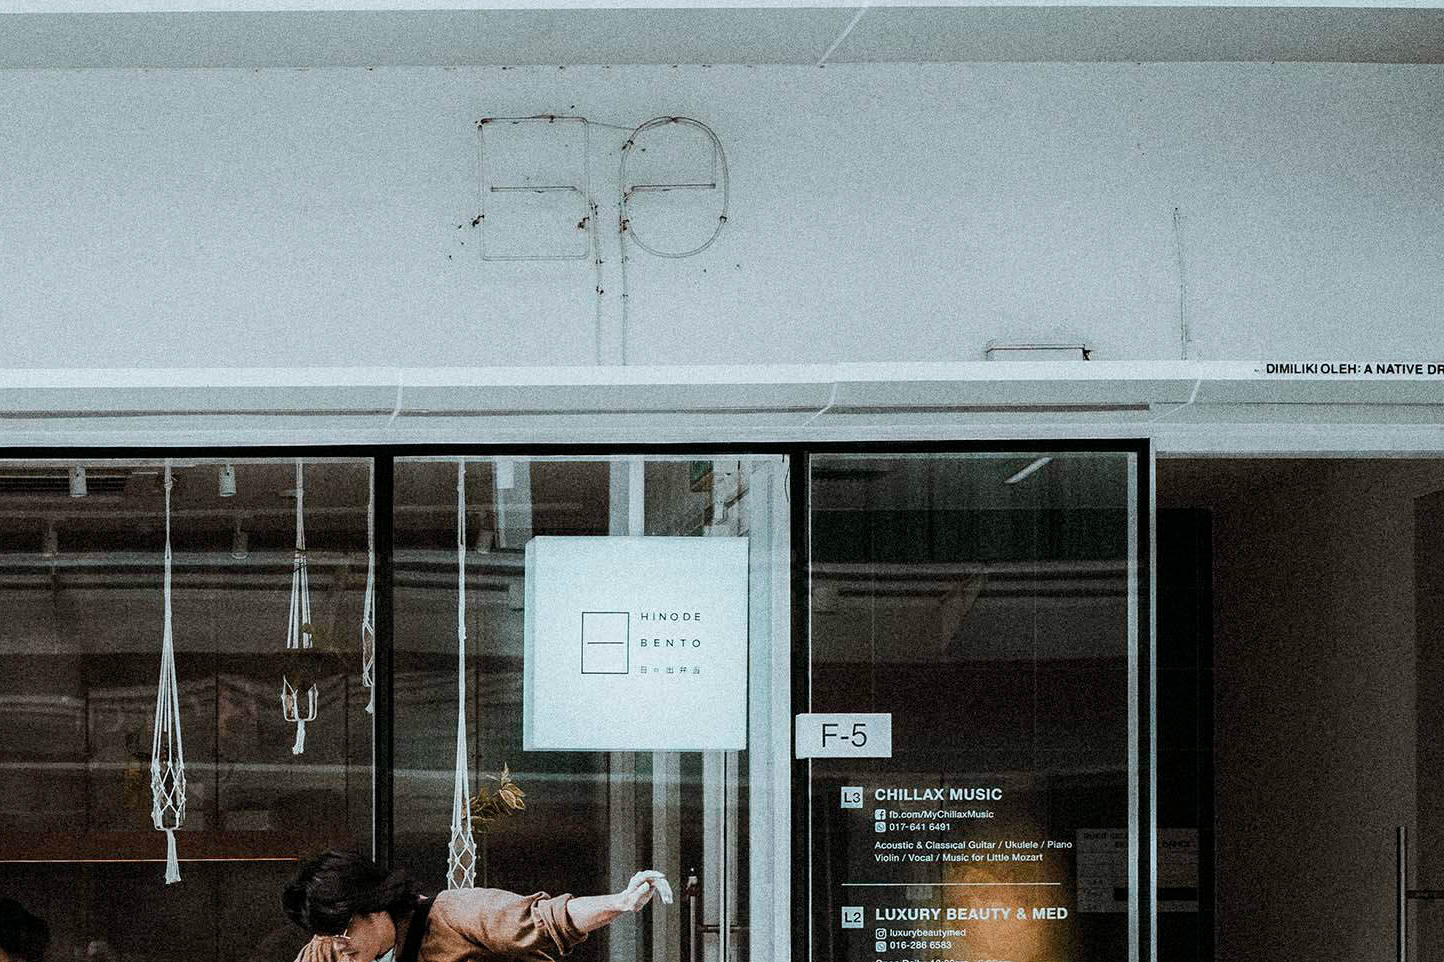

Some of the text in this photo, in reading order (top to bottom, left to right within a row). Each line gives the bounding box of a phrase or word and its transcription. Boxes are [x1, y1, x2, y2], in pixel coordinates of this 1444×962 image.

[1266, 363, 1318, 374] DIMILIKI
[1320, 363, 1361, 374] OLEH:
[1364, 363, 1373, 374] A
[1376, 364, 1423, 375] NATIVE
[640, 612, 701, 622] HINODE
[640, 638, 701, 648] BENTO
[821, 723, 868, 748] F-5
[844, 792, 861, 803] L3
[874, 788, 1003, 801] CHILLAX MUSIC
[889, 810, 994, 820] fb.com/MyChillaxMusic
[889, 823, 950, 831] 017-641 6491
[874, 841, 914, 850] Acoustic
[916, 841, 923, 850] &
[925, 840, 966, 850] Classical
[968, 840, 996, 849] Guitar
[1005, 840, 1038, 849] Ukulele
[1047, 840, 1073, 849] Piano
[874, 853, 899, 862] Violin
[909, 853, 933, 862] Vocal
[942, 853, 969, 862] Music
[972, 853, 984, 862] for
[987, 853, 1009, 862] Little
[1012, 853, 1043, 862] Mozart
[844, 911, 862, 923] L2
[875, 907, 1068, 921] LUXURY BEAUTY & MED
[889, 928, 966, 938] luxurybeautymed
[889, 941, 952, 949] 016-286 6583
